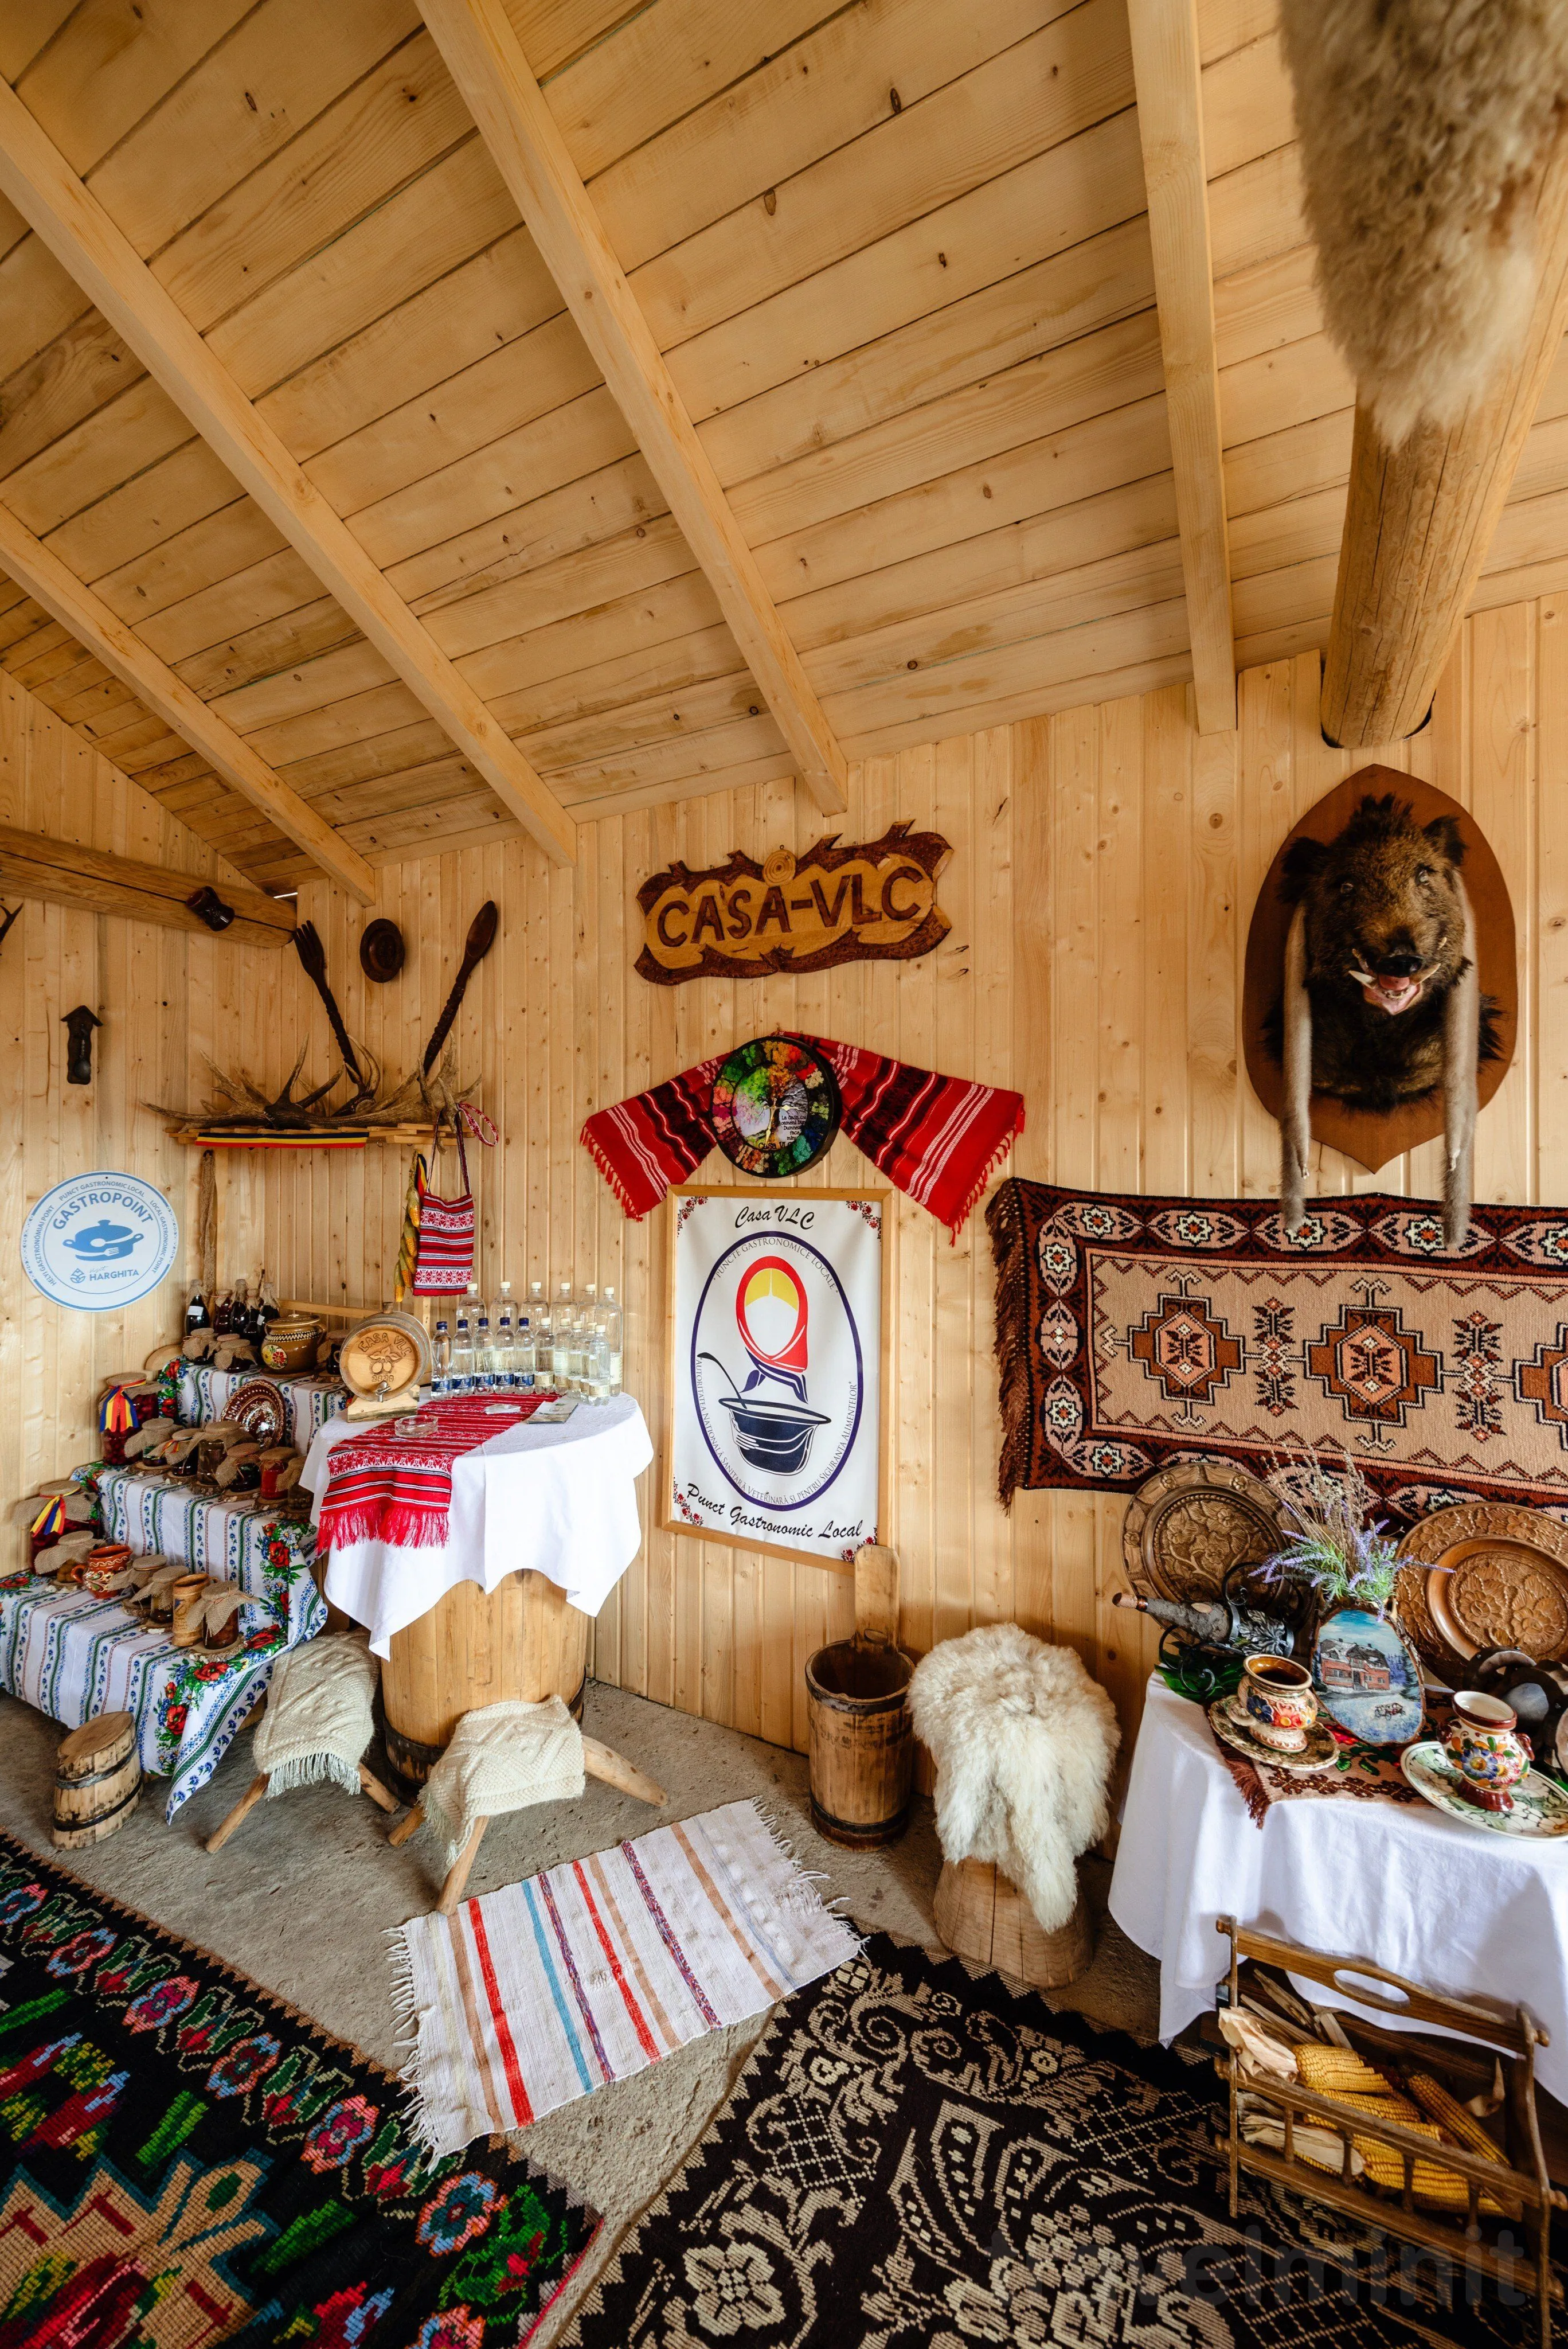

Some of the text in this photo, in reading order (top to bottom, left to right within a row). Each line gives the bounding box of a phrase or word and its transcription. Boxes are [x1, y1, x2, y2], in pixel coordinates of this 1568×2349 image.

[656, 865, 925, 947] CASA-VLC
[58, 1181, 146, 1201] PUNCT GASTRONOMIC LOCAL
[41, 1205, 54, 1222] PONT
[53, 1192, 153, 1230] GASTROPOINT
[735, 1205, 815, 1230] Casa VLC
[150, 1200, 169, 1274] LOCAL GASTRONOMIC POINT
[89, 1269, 139, 1281] HARGHITA
[715, 1237, 836, 1290] PUNCTE GASTRONOMICE LOCALE
[42, 1271, 57, 1286] HELYI
[358, 1332, 412, 1357] CASA VLC
[372, 1374, 394, 1382] 2020
[797, 1478, 822, 1500] PENTRU
[842, 1383, 857, 1441] ALIMENTELOR
[686, 1482, 863, 1539] Punct Gastronomic Local
